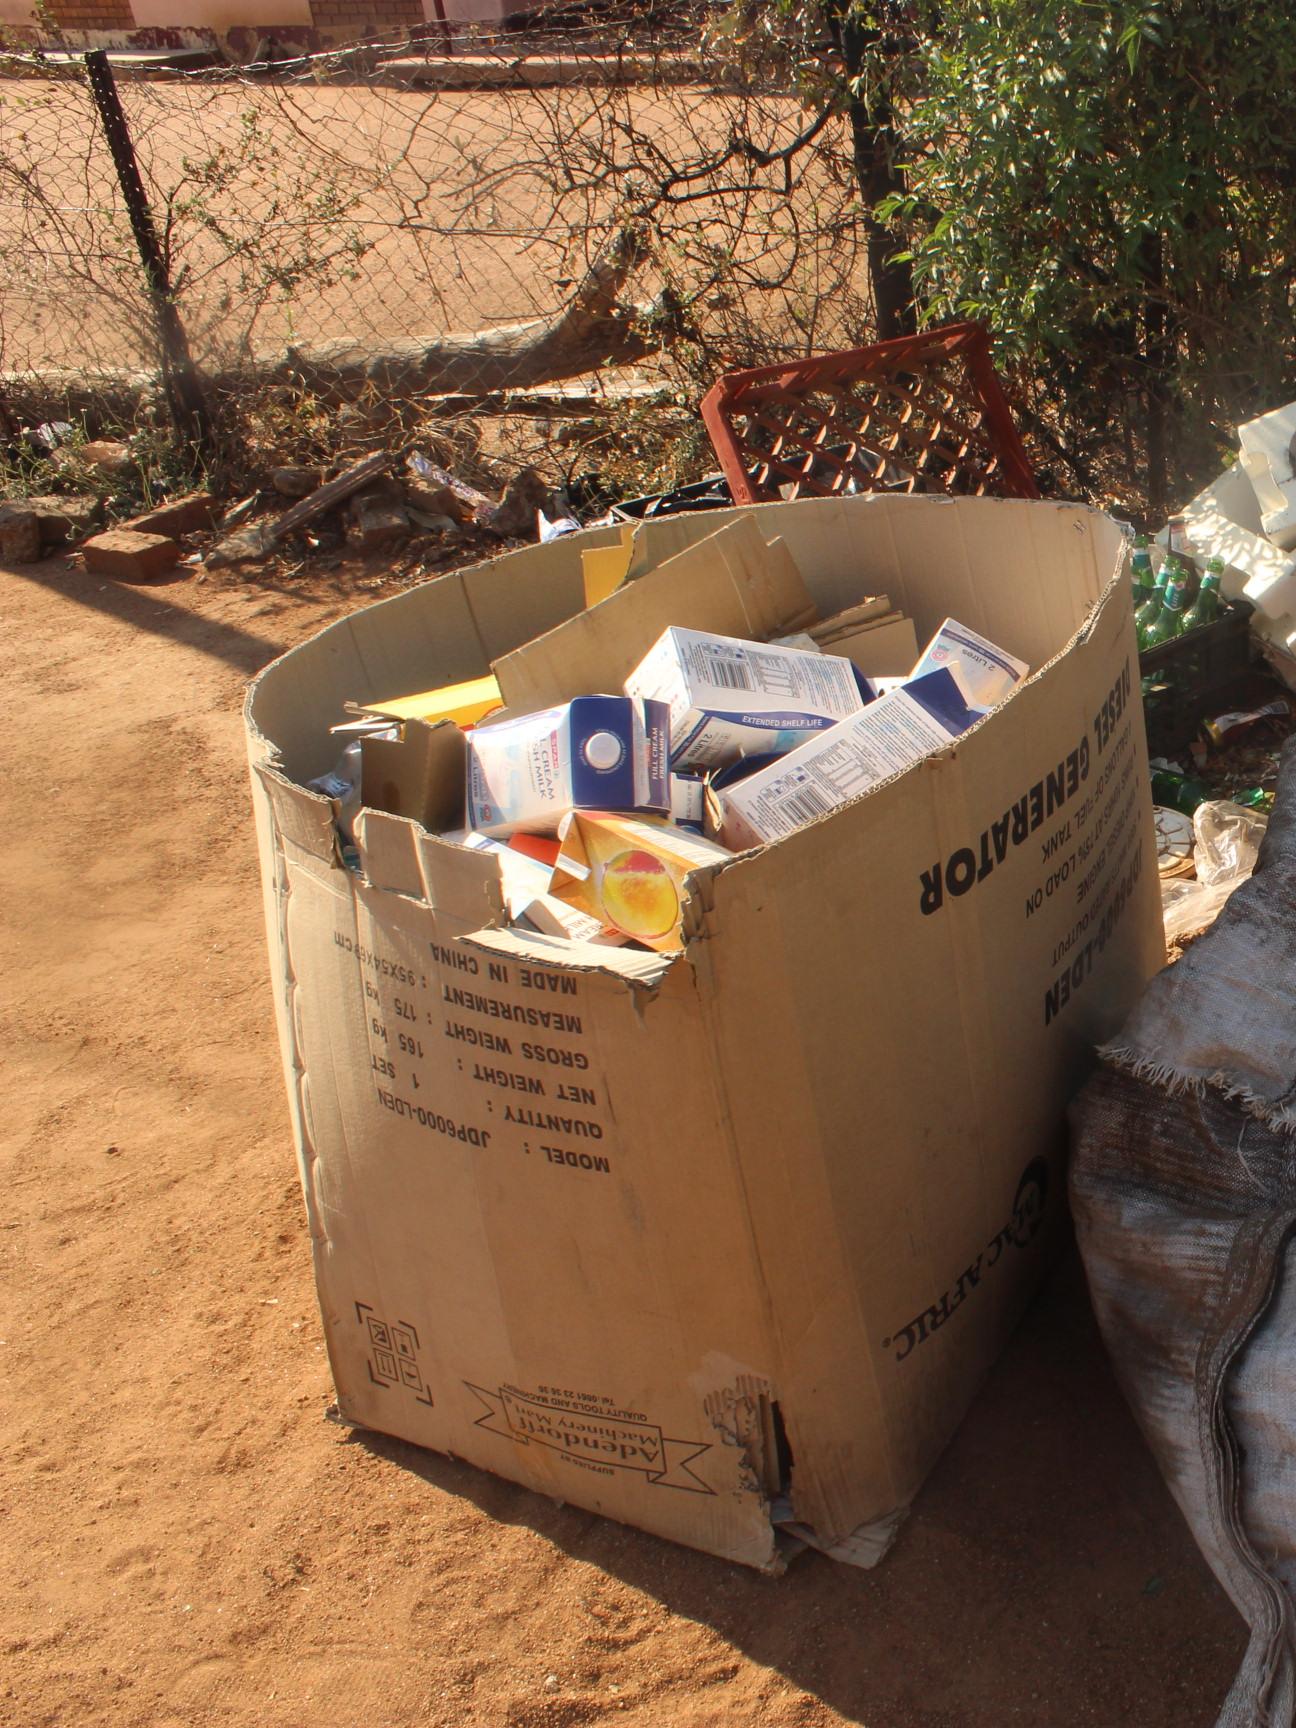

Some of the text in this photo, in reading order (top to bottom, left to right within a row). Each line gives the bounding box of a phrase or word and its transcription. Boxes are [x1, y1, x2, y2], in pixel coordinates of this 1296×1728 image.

[961, 648, 988, 667] Litres
[1094, 655, 1131, 755] DIESEL
[742, 715, 824, 728] EXTENDED SHELF LIFE
[652, 727, 660, 780] FULL CREAM
[535, 766, 547, 799] MILK
[540, 750, 555, 801] CREAM
[1095, 776, 1104, 803] OF
[920, 735, 1090, 916] GENERATOR
[1074, 798, 1094, 830] FUEL
[1042, 821, 1071, 865] TANK
[1046, 853, 1076, 897] LOAD
[1076, 847, 1106, 904] ENGINE
[1026, 887, 1043, 919] ON
[1052, 912, 1090, 967] OUTPUT
[430, 942, 578, 995] MADE IN CHINA
[366, 981, 380, 1005] kg
[442, 984, 582, 1034] MEASUREMENT
[394, 998, 417, 1022] 175
[372, 1018, 388, 1043] kg
[398, 1033, 424, 1058] 165
[446, 1020, 512, 1054] WEIGHT
[371, 1054, 396, 1079] SET
[521, 1042, 589, 1070] GROSS
[412, 1073, 420, 1089] 1
[473, 1063, 546, 1096] WEIGHT
[557, 1083, 596, 1106] NET
[377, 1089, 491, 1148] JDP6000-LDEN
[504, 1105, 603, 1139] QUANTITY
[540, 1146, 611, 1173] MODEL
[502, 1382, 648, 1422] QUALITY TOOLS AND MACHINERY
[563, 1390, 575, 1398] 23
[515, 1416, 660, 1463] Adendorff
[557, 1418, 659, 1447] Machinery
[572, 1458, 615, 1476] SUPPLIED
